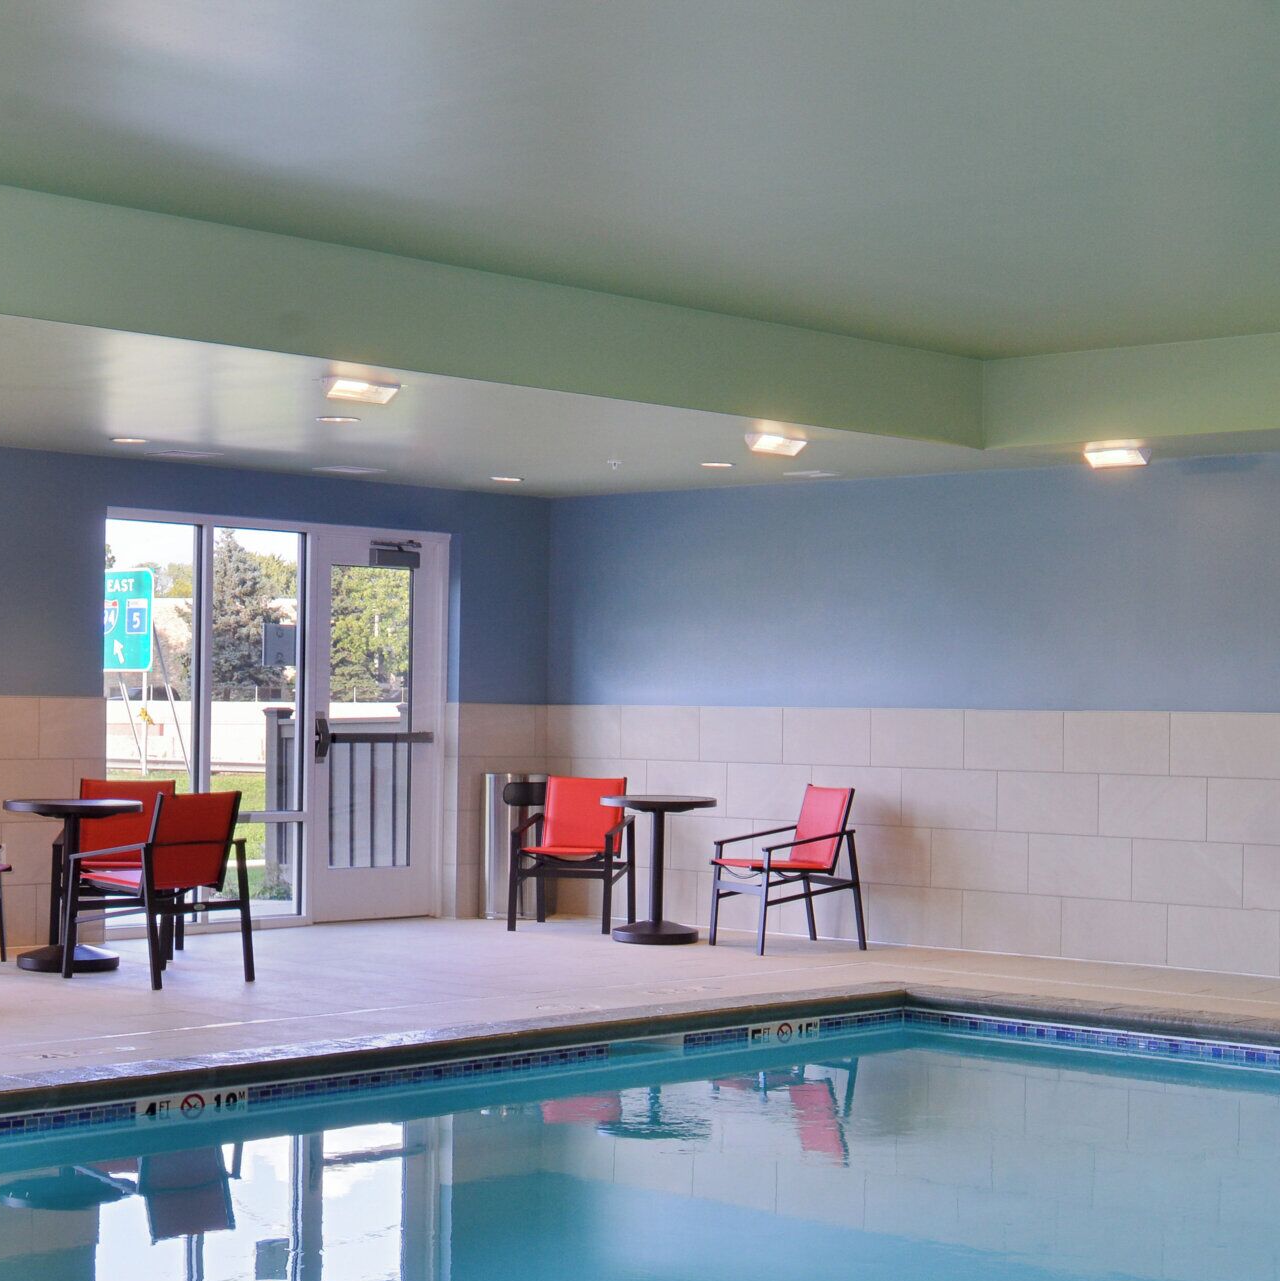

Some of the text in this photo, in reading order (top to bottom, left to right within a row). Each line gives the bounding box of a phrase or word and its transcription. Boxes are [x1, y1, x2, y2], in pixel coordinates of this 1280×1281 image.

[107, 579, 134, 592] EAST
[132, 612, 141, 629] 5
[239, 1091, 246, 1099] M
